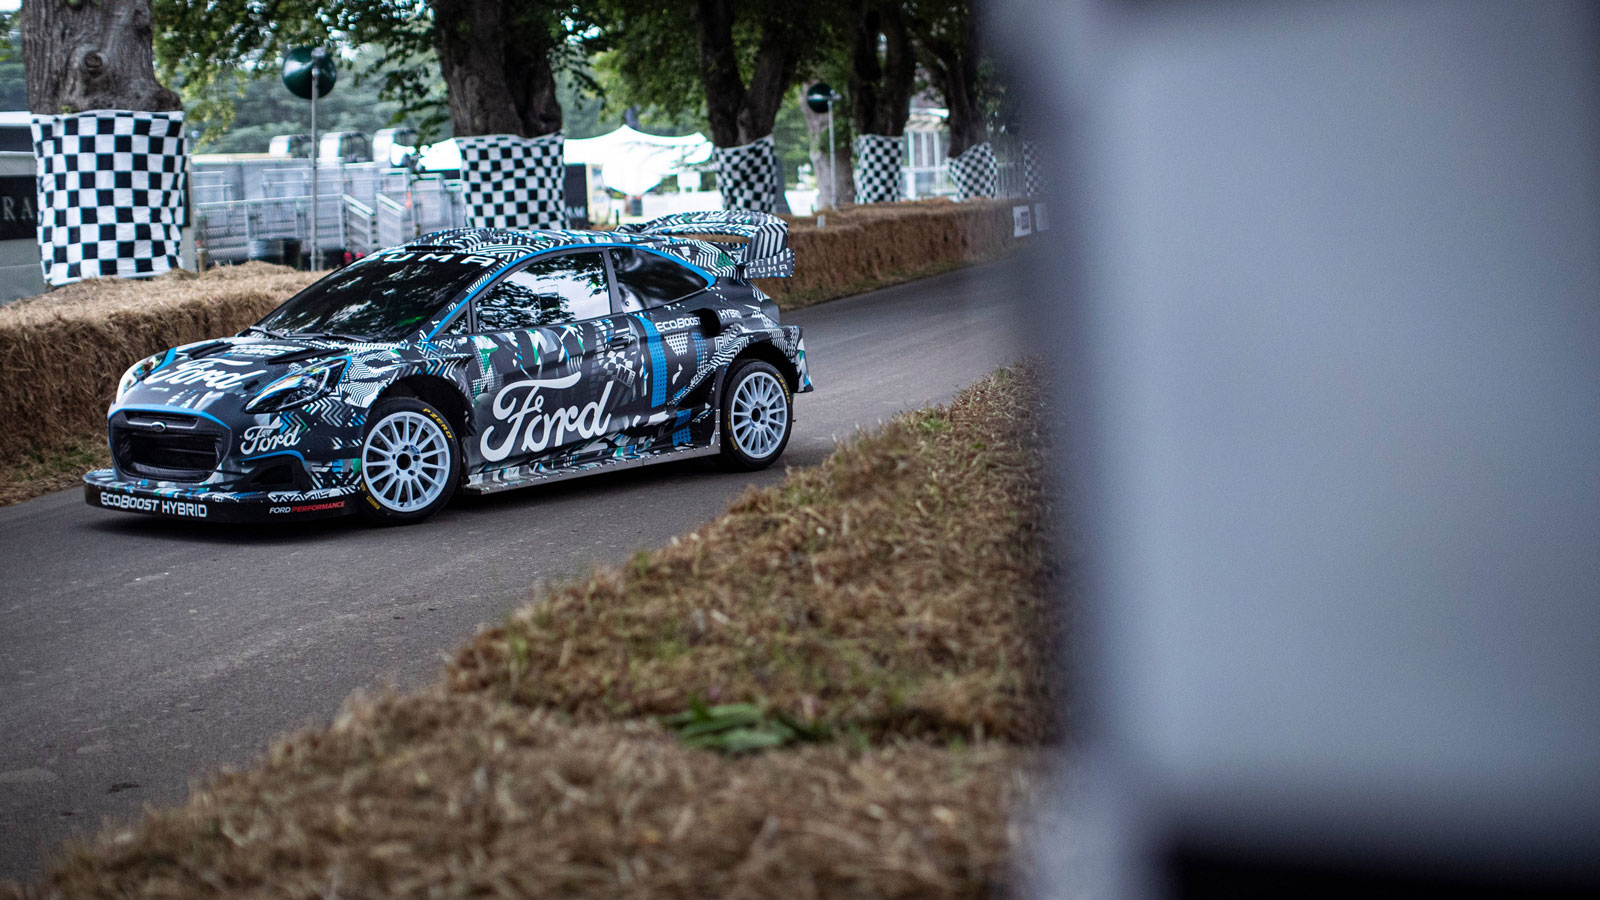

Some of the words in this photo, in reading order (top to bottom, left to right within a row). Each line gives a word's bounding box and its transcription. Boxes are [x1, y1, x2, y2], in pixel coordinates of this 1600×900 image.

[749, 264, 788, 275] PUMA
[143, 358, 267, 390] Ford
[480, 371, 614, 462] Ford
[240, 423, 301, 455] Ford
[161, 500, 208, 518] HYBRID
[269, 506, 291, 514] FORD
[291, 501, 345, 512] PERFORMANCE
